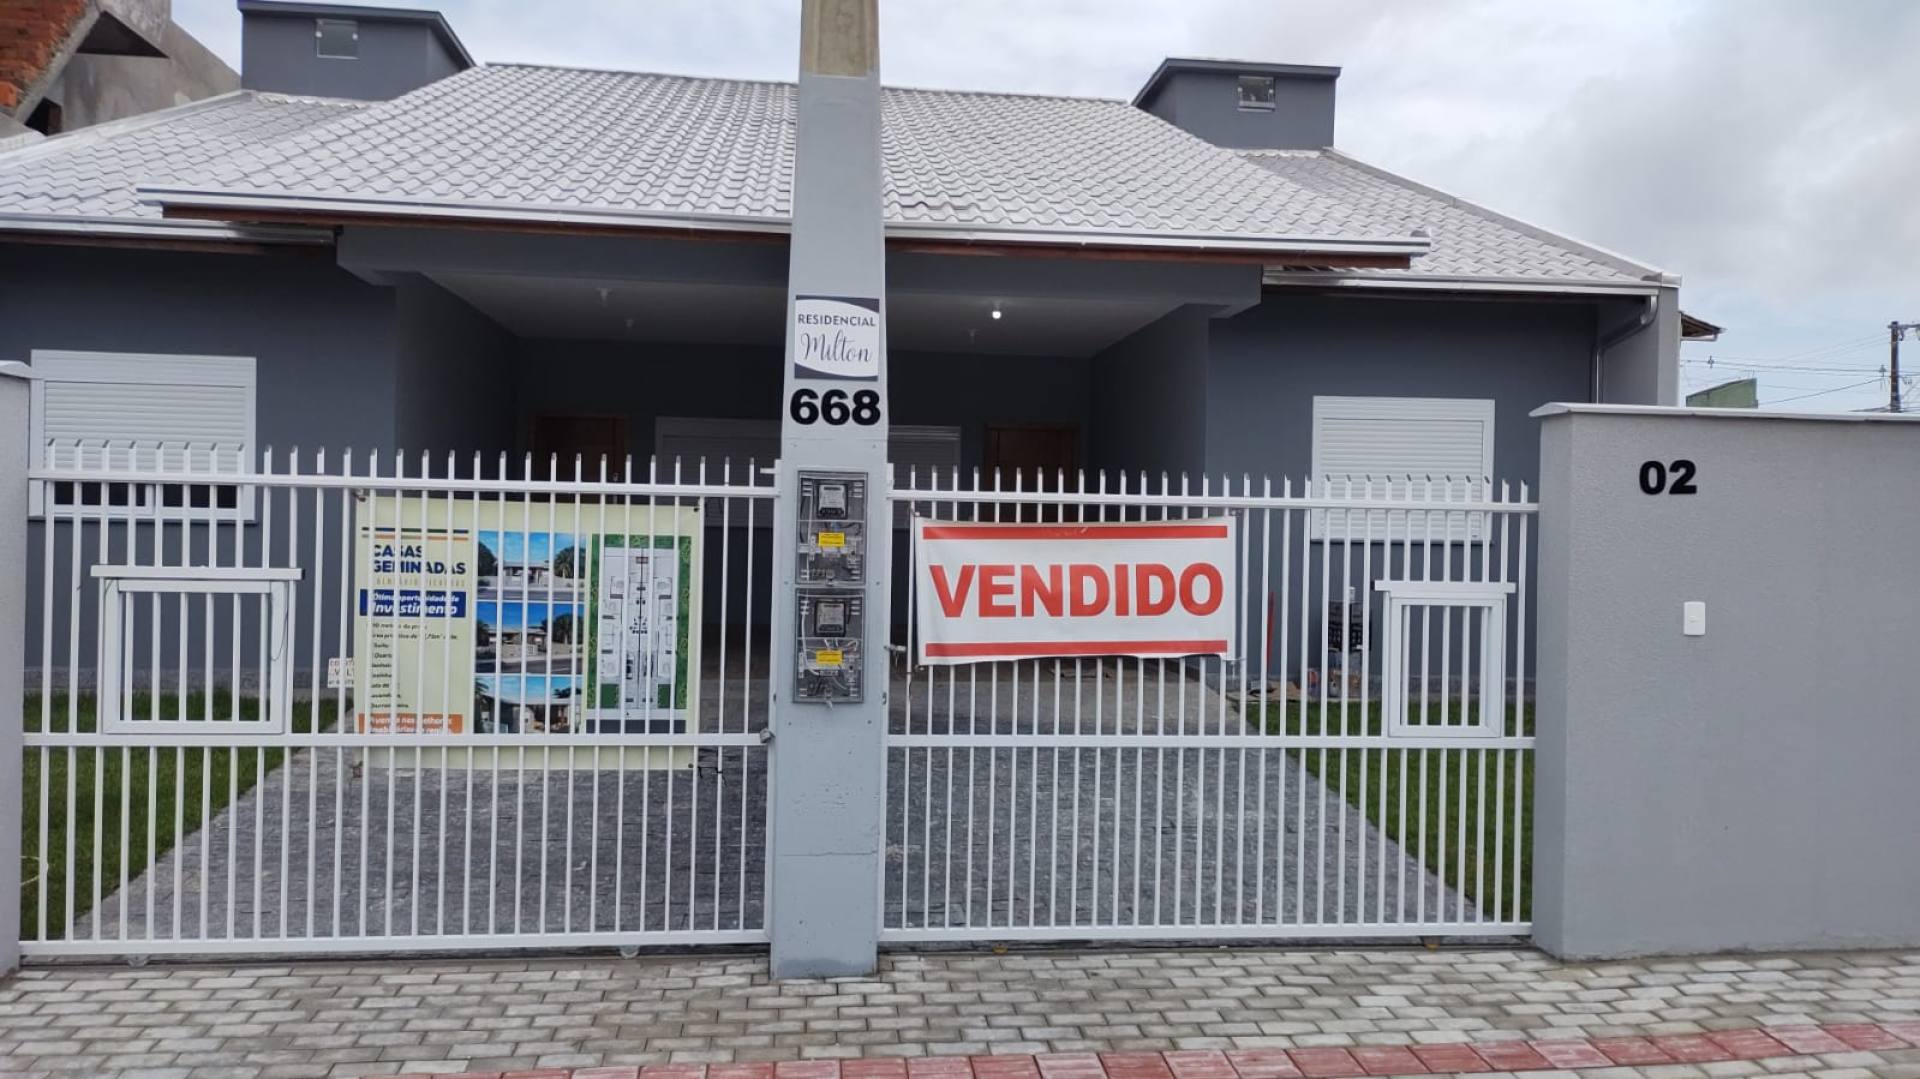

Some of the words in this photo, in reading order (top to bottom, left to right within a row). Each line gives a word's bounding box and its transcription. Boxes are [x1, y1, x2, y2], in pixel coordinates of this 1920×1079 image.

[798, 313, 876, 327] RESIDENCIAL
[800, 329, 871, 362] Milton
[790, 388, 881, 426] 668
[1639, 459, 1698, 495] 02
[372, 544, 422, 558] CAAS
[929, 562, 1223, 618] VENDIDO
